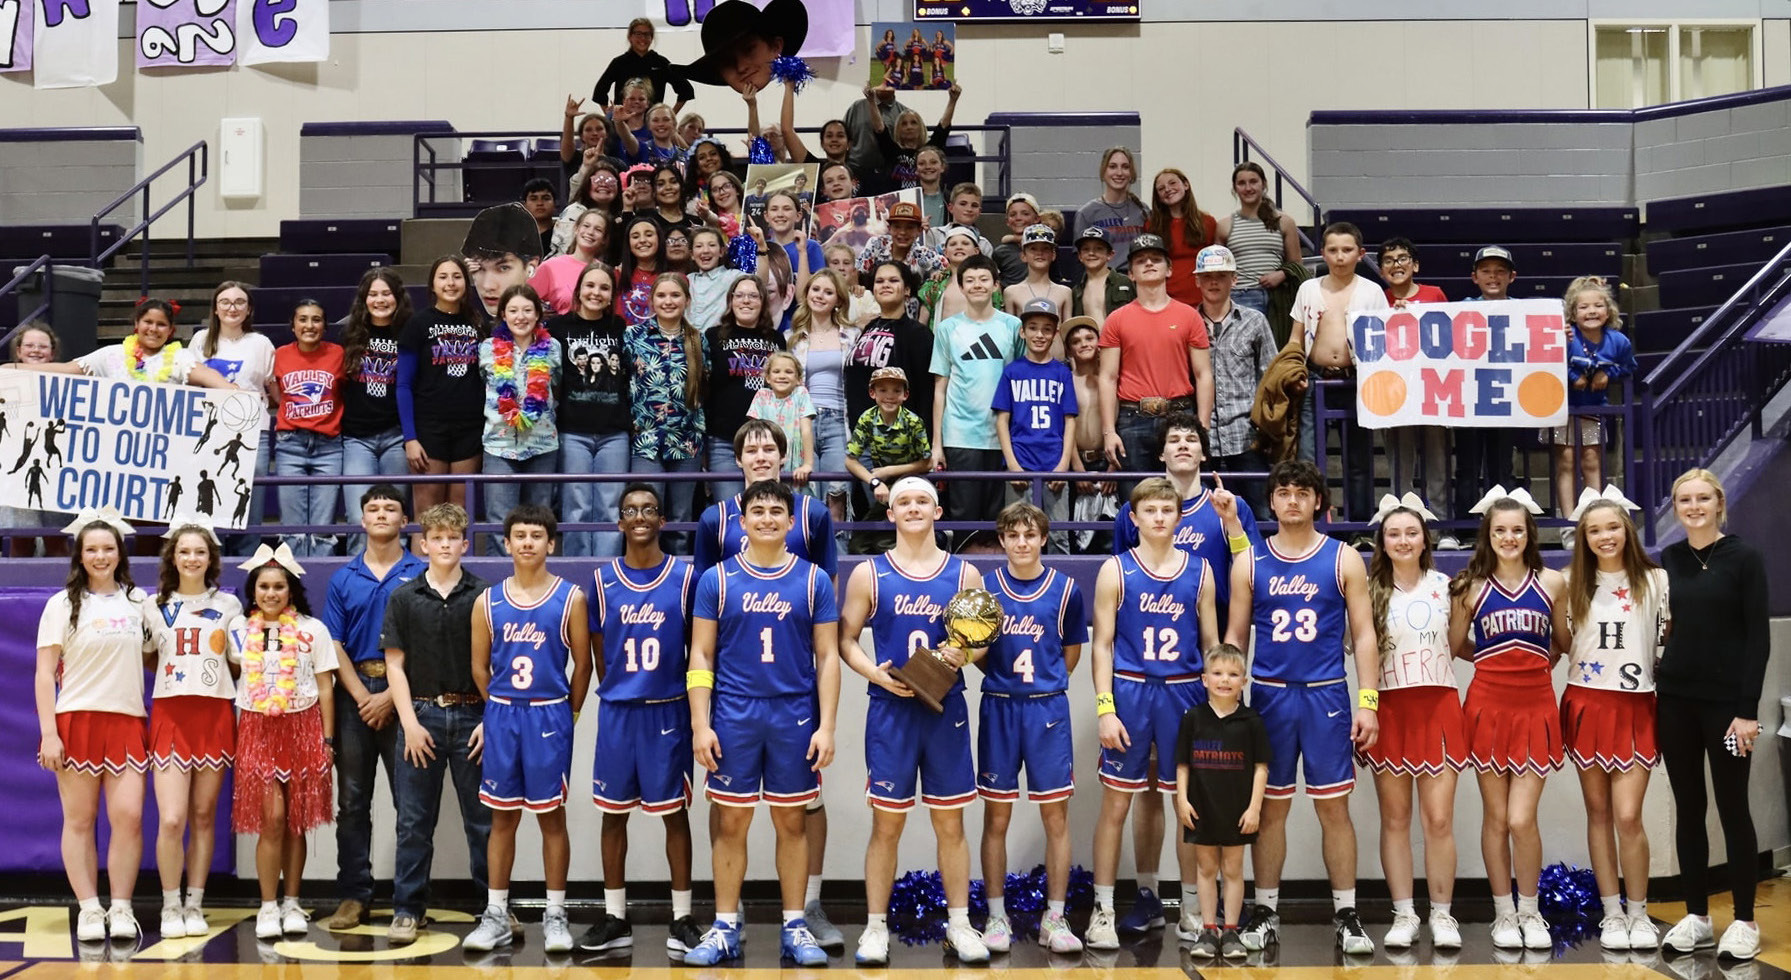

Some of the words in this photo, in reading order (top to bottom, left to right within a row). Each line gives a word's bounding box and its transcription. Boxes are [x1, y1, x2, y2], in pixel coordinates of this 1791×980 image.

[926, 7, 949, 16] BONUS
[1106, 6, 1129, 14] BONUS
[751, 208, 762, 216] 24
[1352, 310, 1565, 364] GOOGLE
[282, 369, 335, 390] VALLEY
[1010, 379, 1064, 403] VALLEY
[1421, 368, 1512, 418] ME
[39, 374, 207, 438] WELCOME
[286, 400, 334, 420] PATRIOTS
[1030, 405, 1051, 429] 15
[63, 422, 101, 464] TO
[115, 429, 170, 470] OUR
[57, 466, 171, 521] COURT
[1172, 526, 1205, 550] alley
[1269, 575, 1319, 602] Valley
[158, 601, 184, 628] V
[620, 603, 665, 631] Valley
[742, 591, 792, 621] Valley
[894, 593, 943, 623] Valley
[1139, 592, 1185, 622] Valley
[503, 622, 546, 650] Valley
[1002, 614, 1045, 643] Valley
[1271, 608, 1318, 643] 23
[1419, 630, 1438, 645] MY
[1481, 608, 1549, 638] PATRIOTS
[1597, 621, 1625, 650] H
[175, 627, 202, 656] H
[624, 637, 661, 672] 10
[760, 626, 775, 663] 1
[1142, 626, 1181, 662] 12
[201, 658, 219, 687] S
[511, 655, 534, 690] 3
[1013, 648, 1036, 684] 4
[1382, 648, 1449, 688] HERO
[1619, 662, 1642, 690] S
[1193, 750, 1245, 760] PATRIOTS
